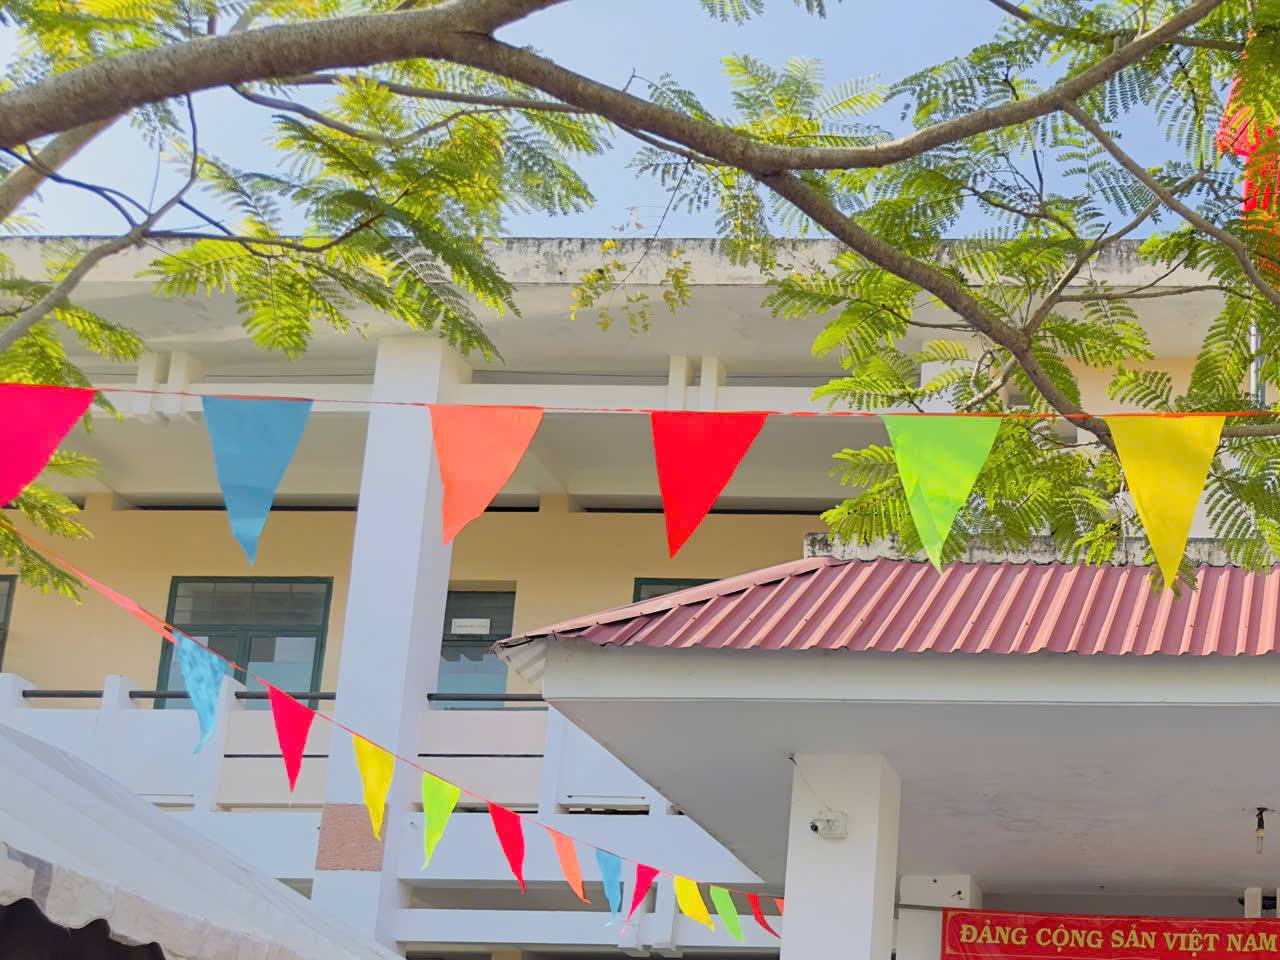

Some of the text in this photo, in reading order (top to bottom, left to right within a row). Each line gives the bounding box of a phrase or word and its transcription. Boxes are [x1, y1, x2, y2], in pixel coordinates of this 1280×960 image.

[960, 920, 1028, 946] ĐẢNG
[1035, 924, 1104, 952] CỘNG
[1111, 923, 1157, 949] SẢN
[1163, 928, 1220, 957] VIỆT
[1226, 932, 1277, 951] NAM
